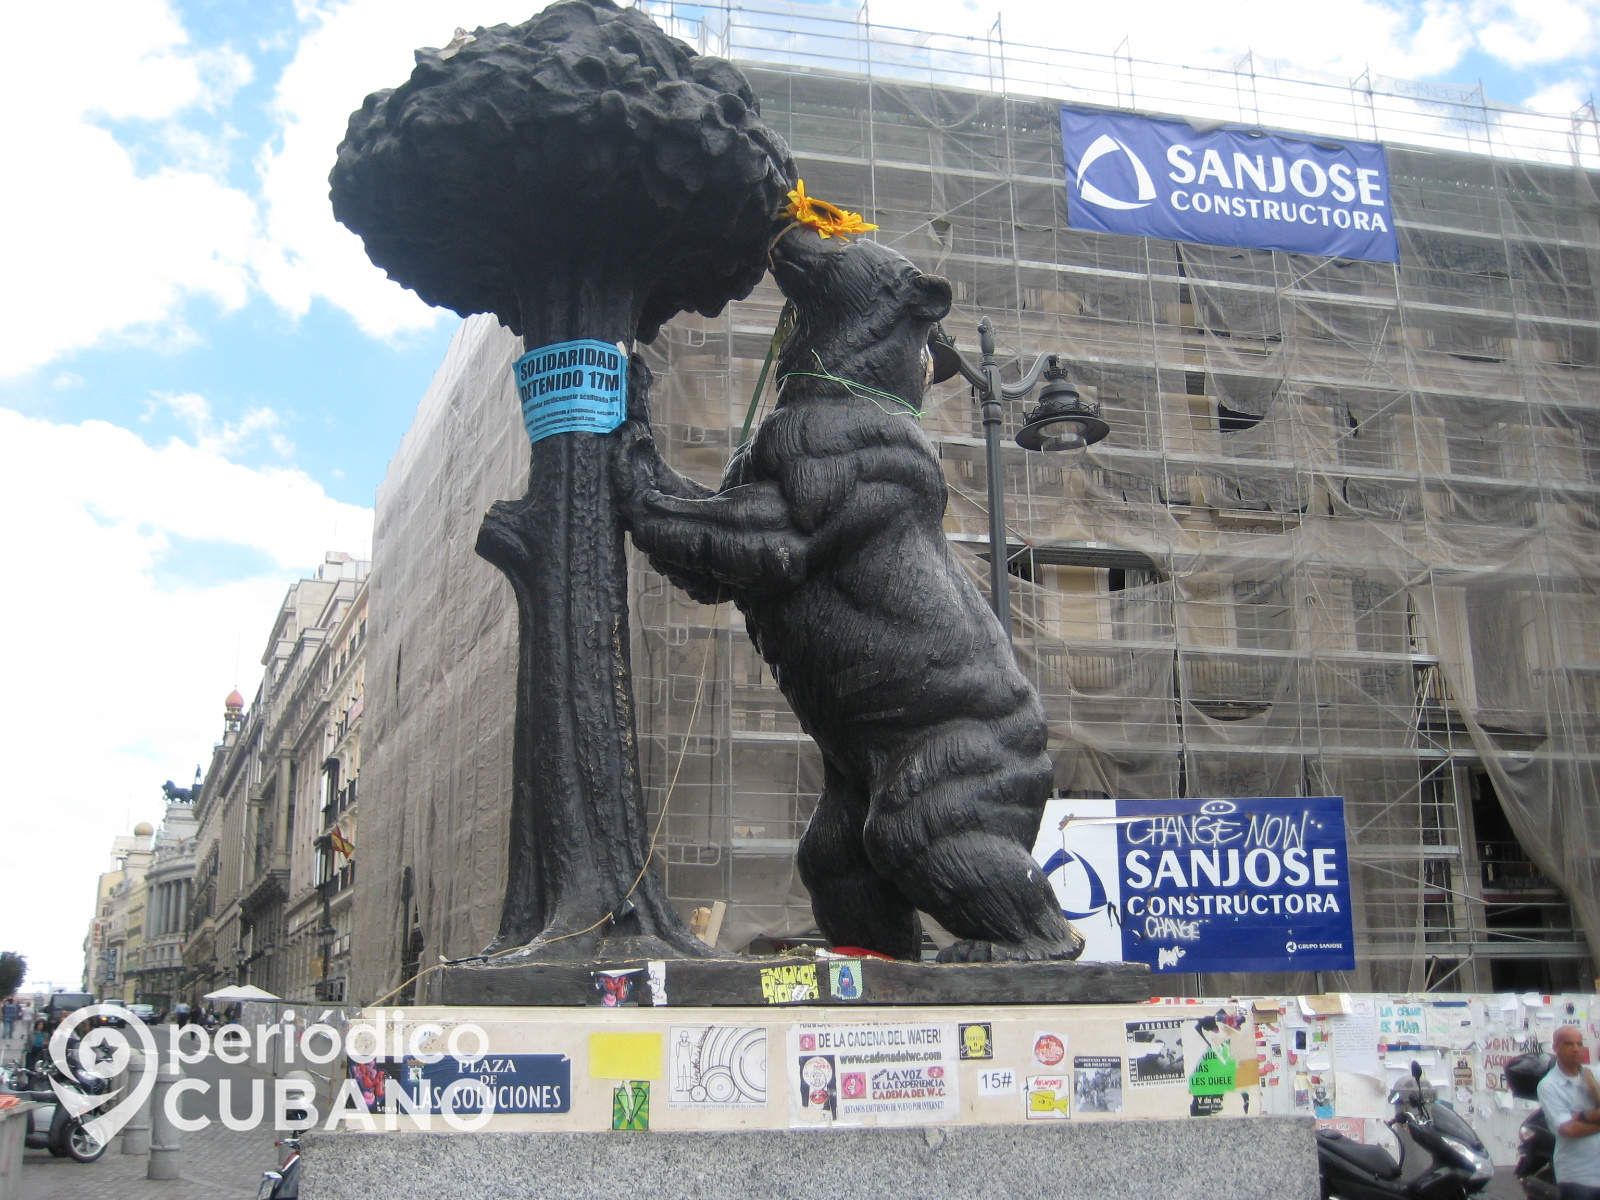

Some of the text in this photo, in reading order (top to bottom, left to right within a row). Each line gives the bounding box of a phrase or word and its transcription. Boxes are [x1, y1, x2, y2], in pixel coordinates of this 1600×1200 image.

[1166, 144, 1385, 207] SANJOSE
[1170, 190, 1388, 233] CONSTRUCTORA
[521, 347, 619, 382] SOLIDARIDAD
[521, 369, 620, 404] DETENIDO 17M
[1126, 815, 1243, 848] CHANGE
[1125, 848, 1339, 889] SANJOSE
[1127, 893, 1340, 916] CONSTRUCTORA
[1145, 916, 1201, 941] CHANGE
[1319, 942, 1343, 950] SANJOSE
[818, 1028, 942, 1048] DE LA CADENA DEL WATER!
[458, 1058, 517, 1073] PLAZA
[886, 1071, 900, 1081] LA
[900, 1069, 923, 1080] VOZ
[480, 1075, 498, 1085] DE
[872, 1079, 945, 1091] DE LA EXPERIENCIA
[981, 1071, 1012, 1089] 15#
[1191, 1077, 1206, 1086] LES
[1208, 1076, 1232, 1086] DUELE
[412, 1085, 561, 1109] LAS SOLUCIONES
[872, 1087, 946, 1100] CADENA DEL W.C.
